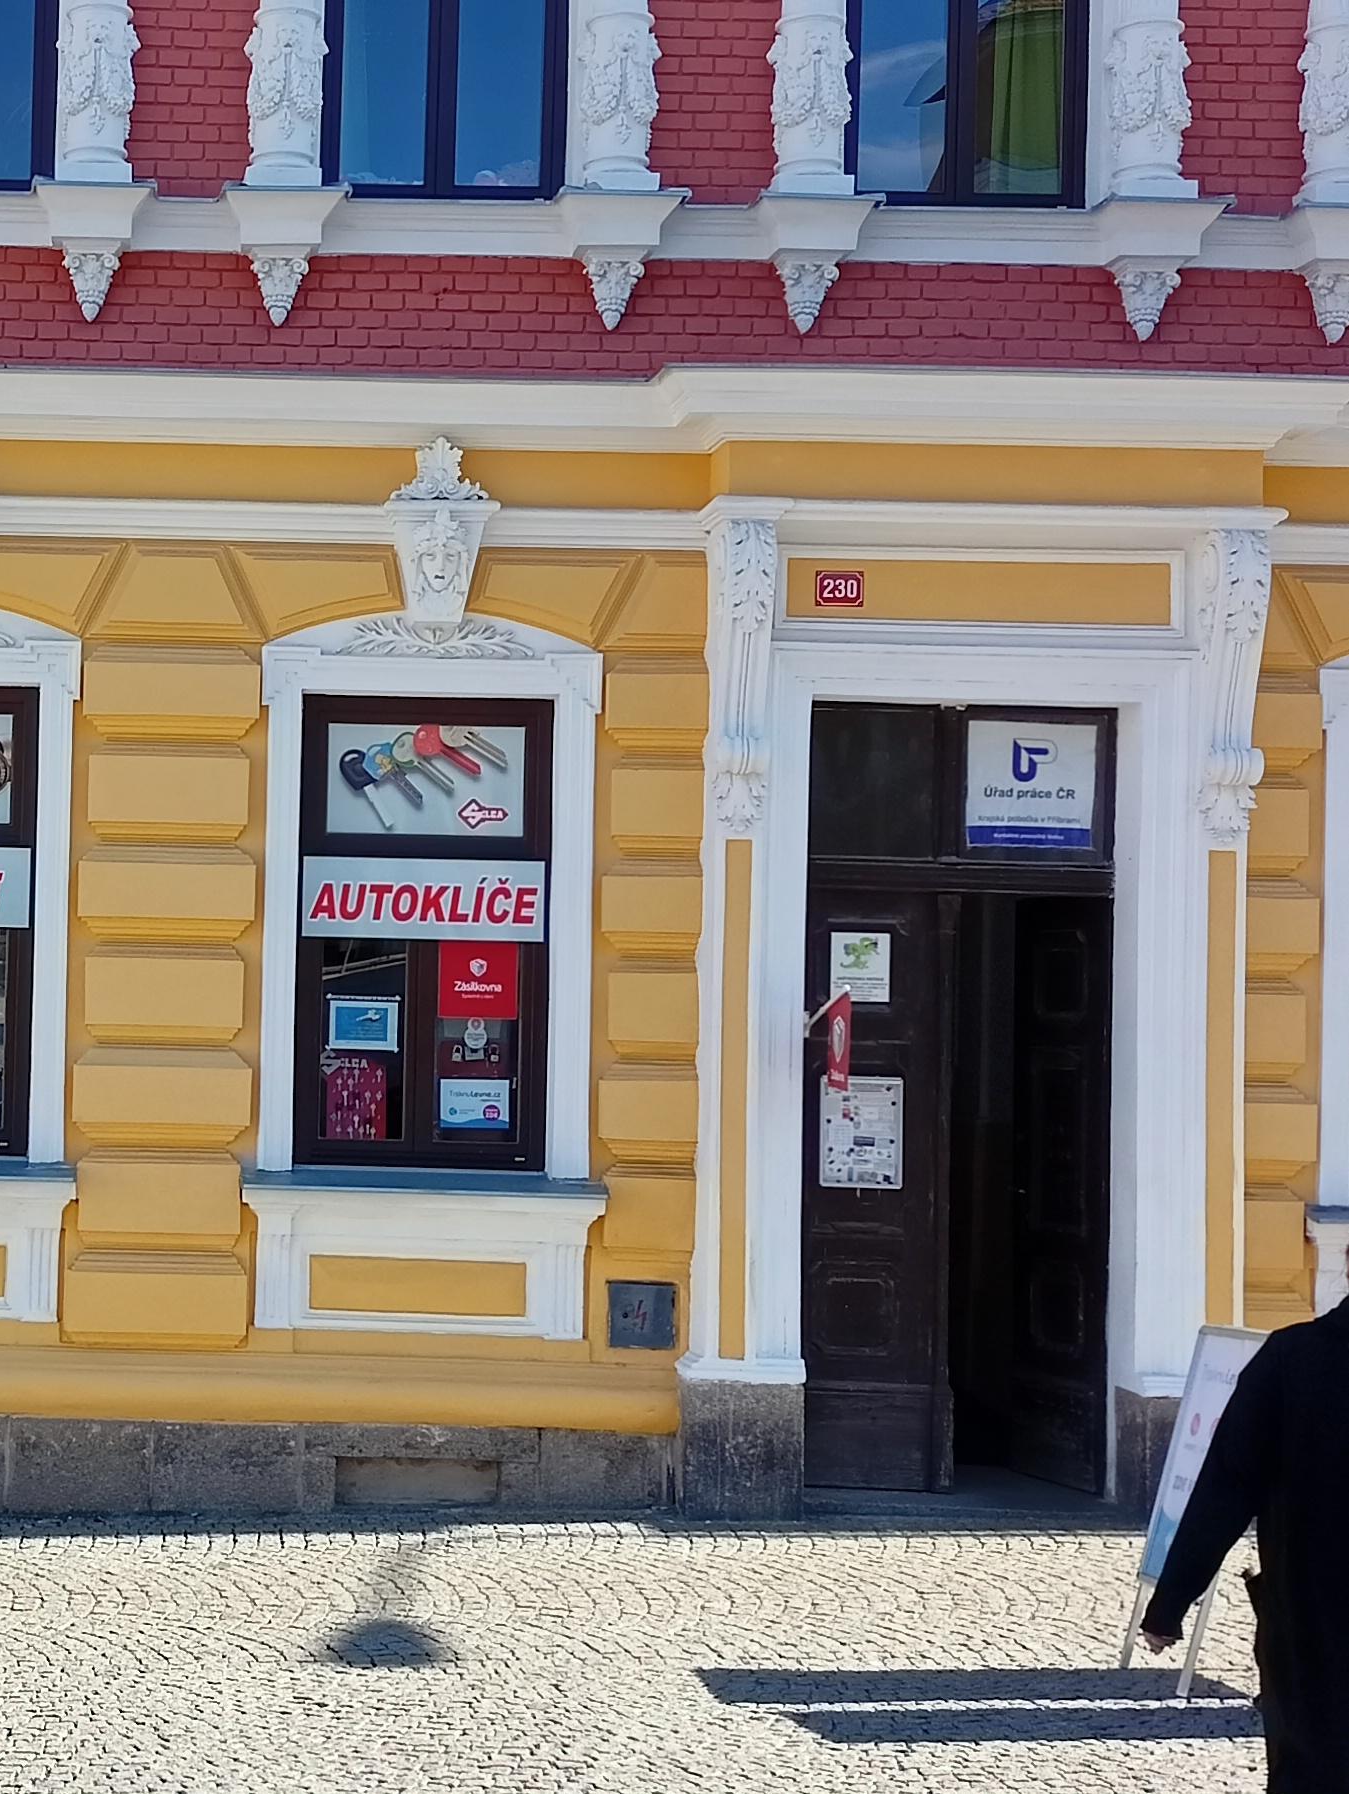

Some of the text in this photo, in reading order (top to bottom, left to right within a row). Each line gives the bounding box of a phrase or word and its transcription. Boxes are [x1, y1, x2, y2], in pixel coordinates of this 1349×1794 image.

[822, 578, 858, 599] 230
[983, 784, 1076, 800] Úřad práce ČR
[309, 877, 539, 924] AUTOKLÍČE
[453, 980, 503, 993] Zásilkovna
